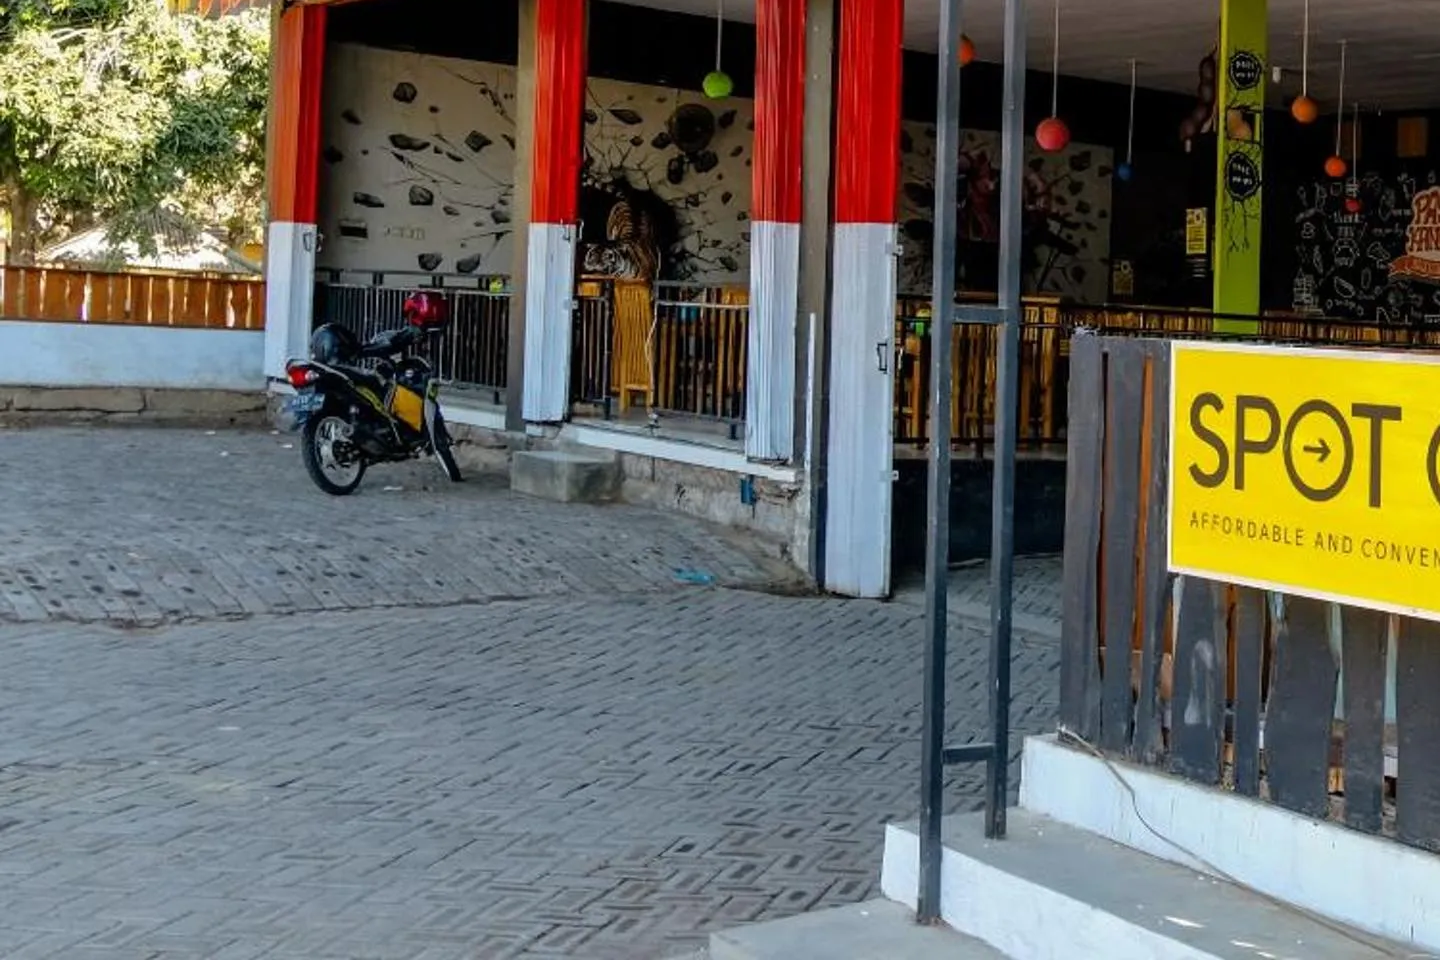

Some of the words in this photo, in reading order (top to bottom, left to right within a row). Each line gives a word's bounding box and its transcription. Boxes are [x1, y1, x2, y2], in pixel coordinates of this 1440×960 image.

[1188, 390, 1403, 509] SPOT
[1189, 511, 1305, 546] AFFORDABLE
[1314, 531, 1353, 554] AND
